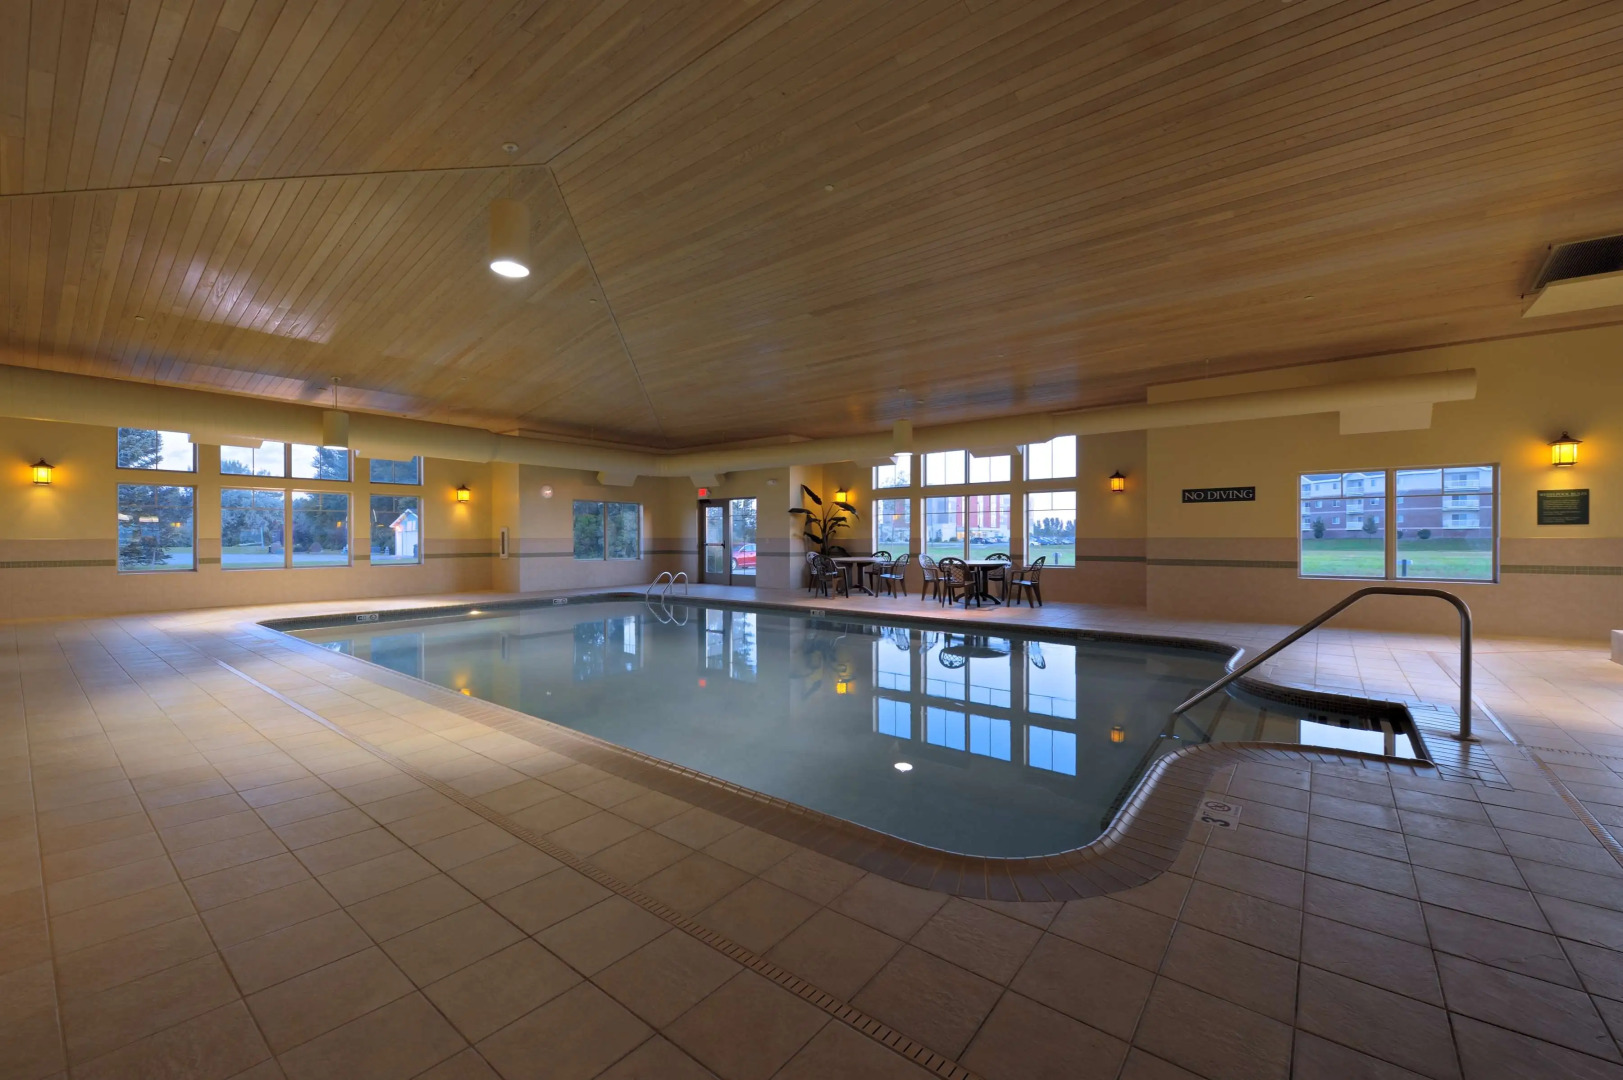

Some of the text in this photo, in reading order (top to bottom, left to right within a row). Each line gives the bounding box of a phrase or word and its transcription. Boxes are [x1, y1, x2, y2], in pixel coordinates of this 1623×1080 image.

[1184, 490, 1253, 500] NO DIVING
[1201, 816, 1230, 827] 3
